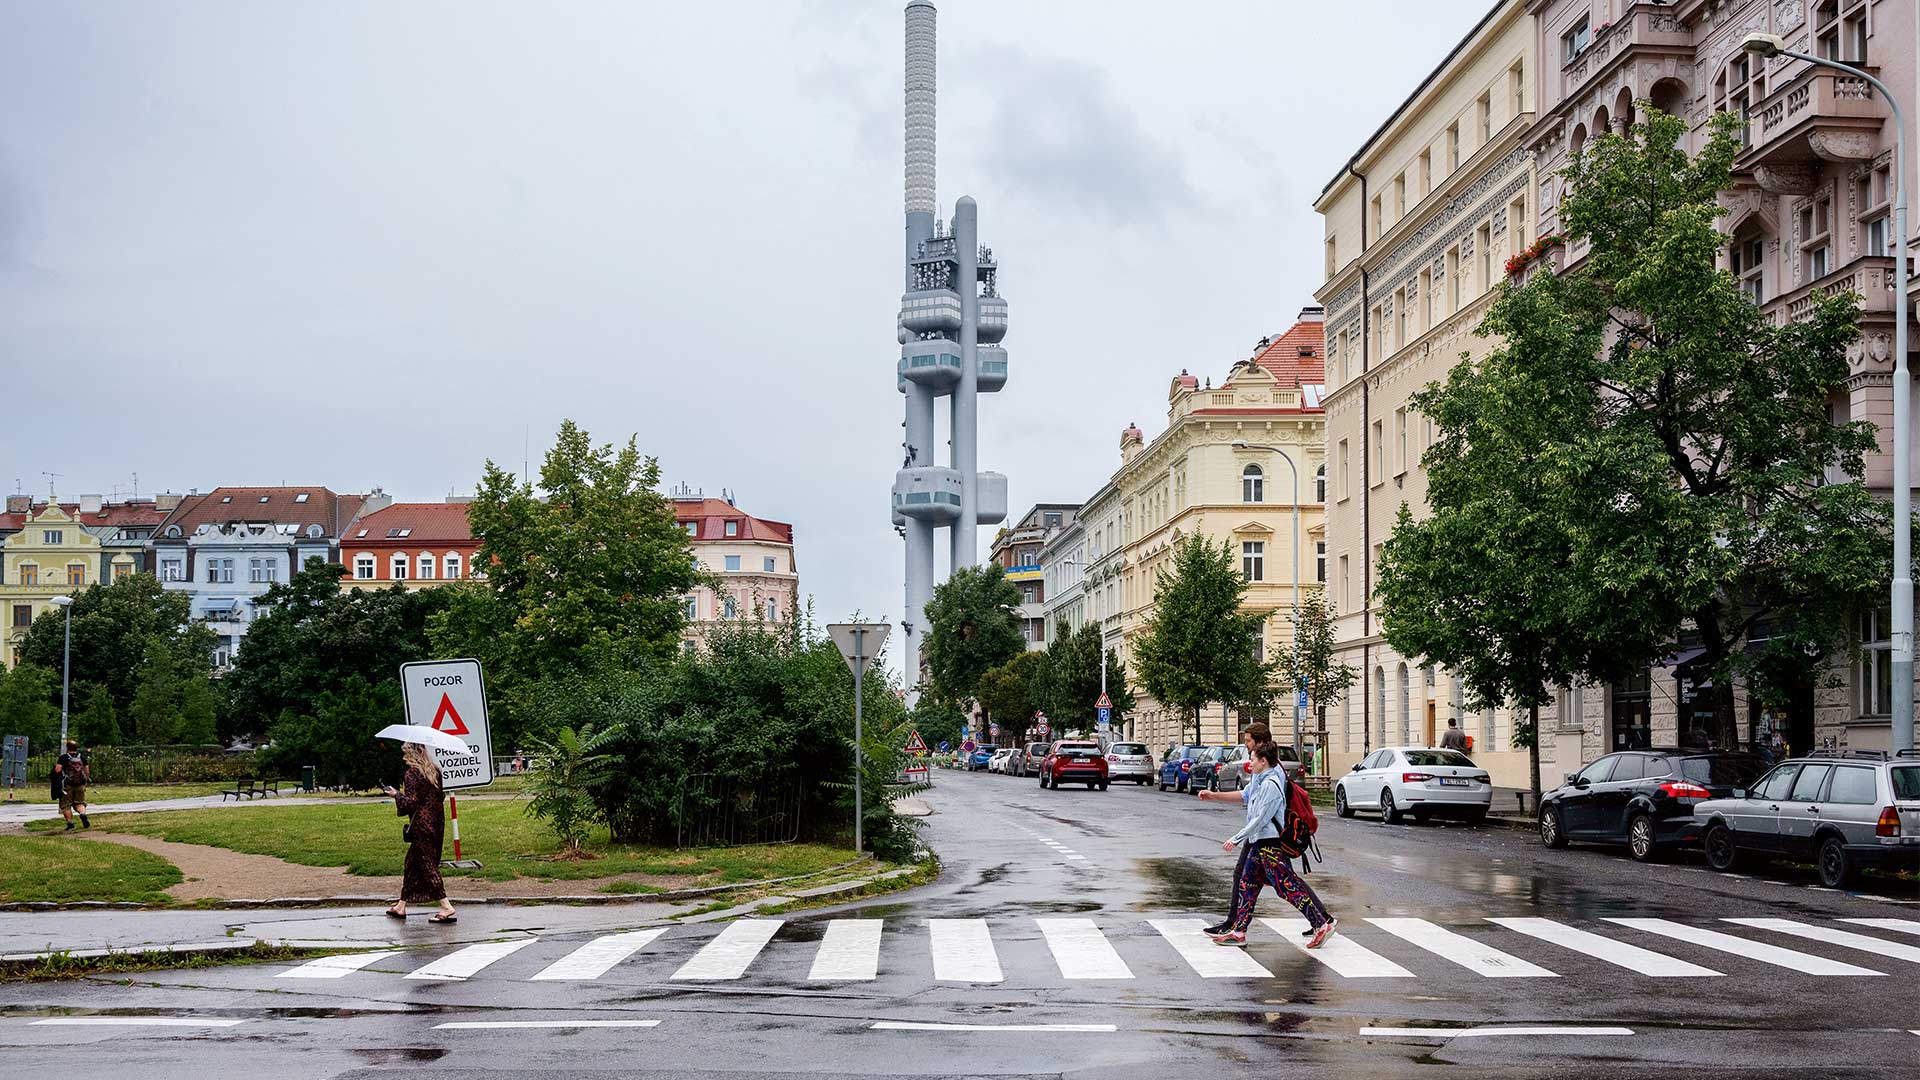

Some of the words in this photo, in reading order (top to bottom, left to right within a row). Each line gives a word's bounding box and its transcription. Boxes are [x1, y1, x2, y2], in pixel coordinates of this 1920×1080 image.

[424, 675, 463, 687] POZOR
[439, 756, 481, 768] VOZIDEL
[442, 768, 480, 780] STAVBY
